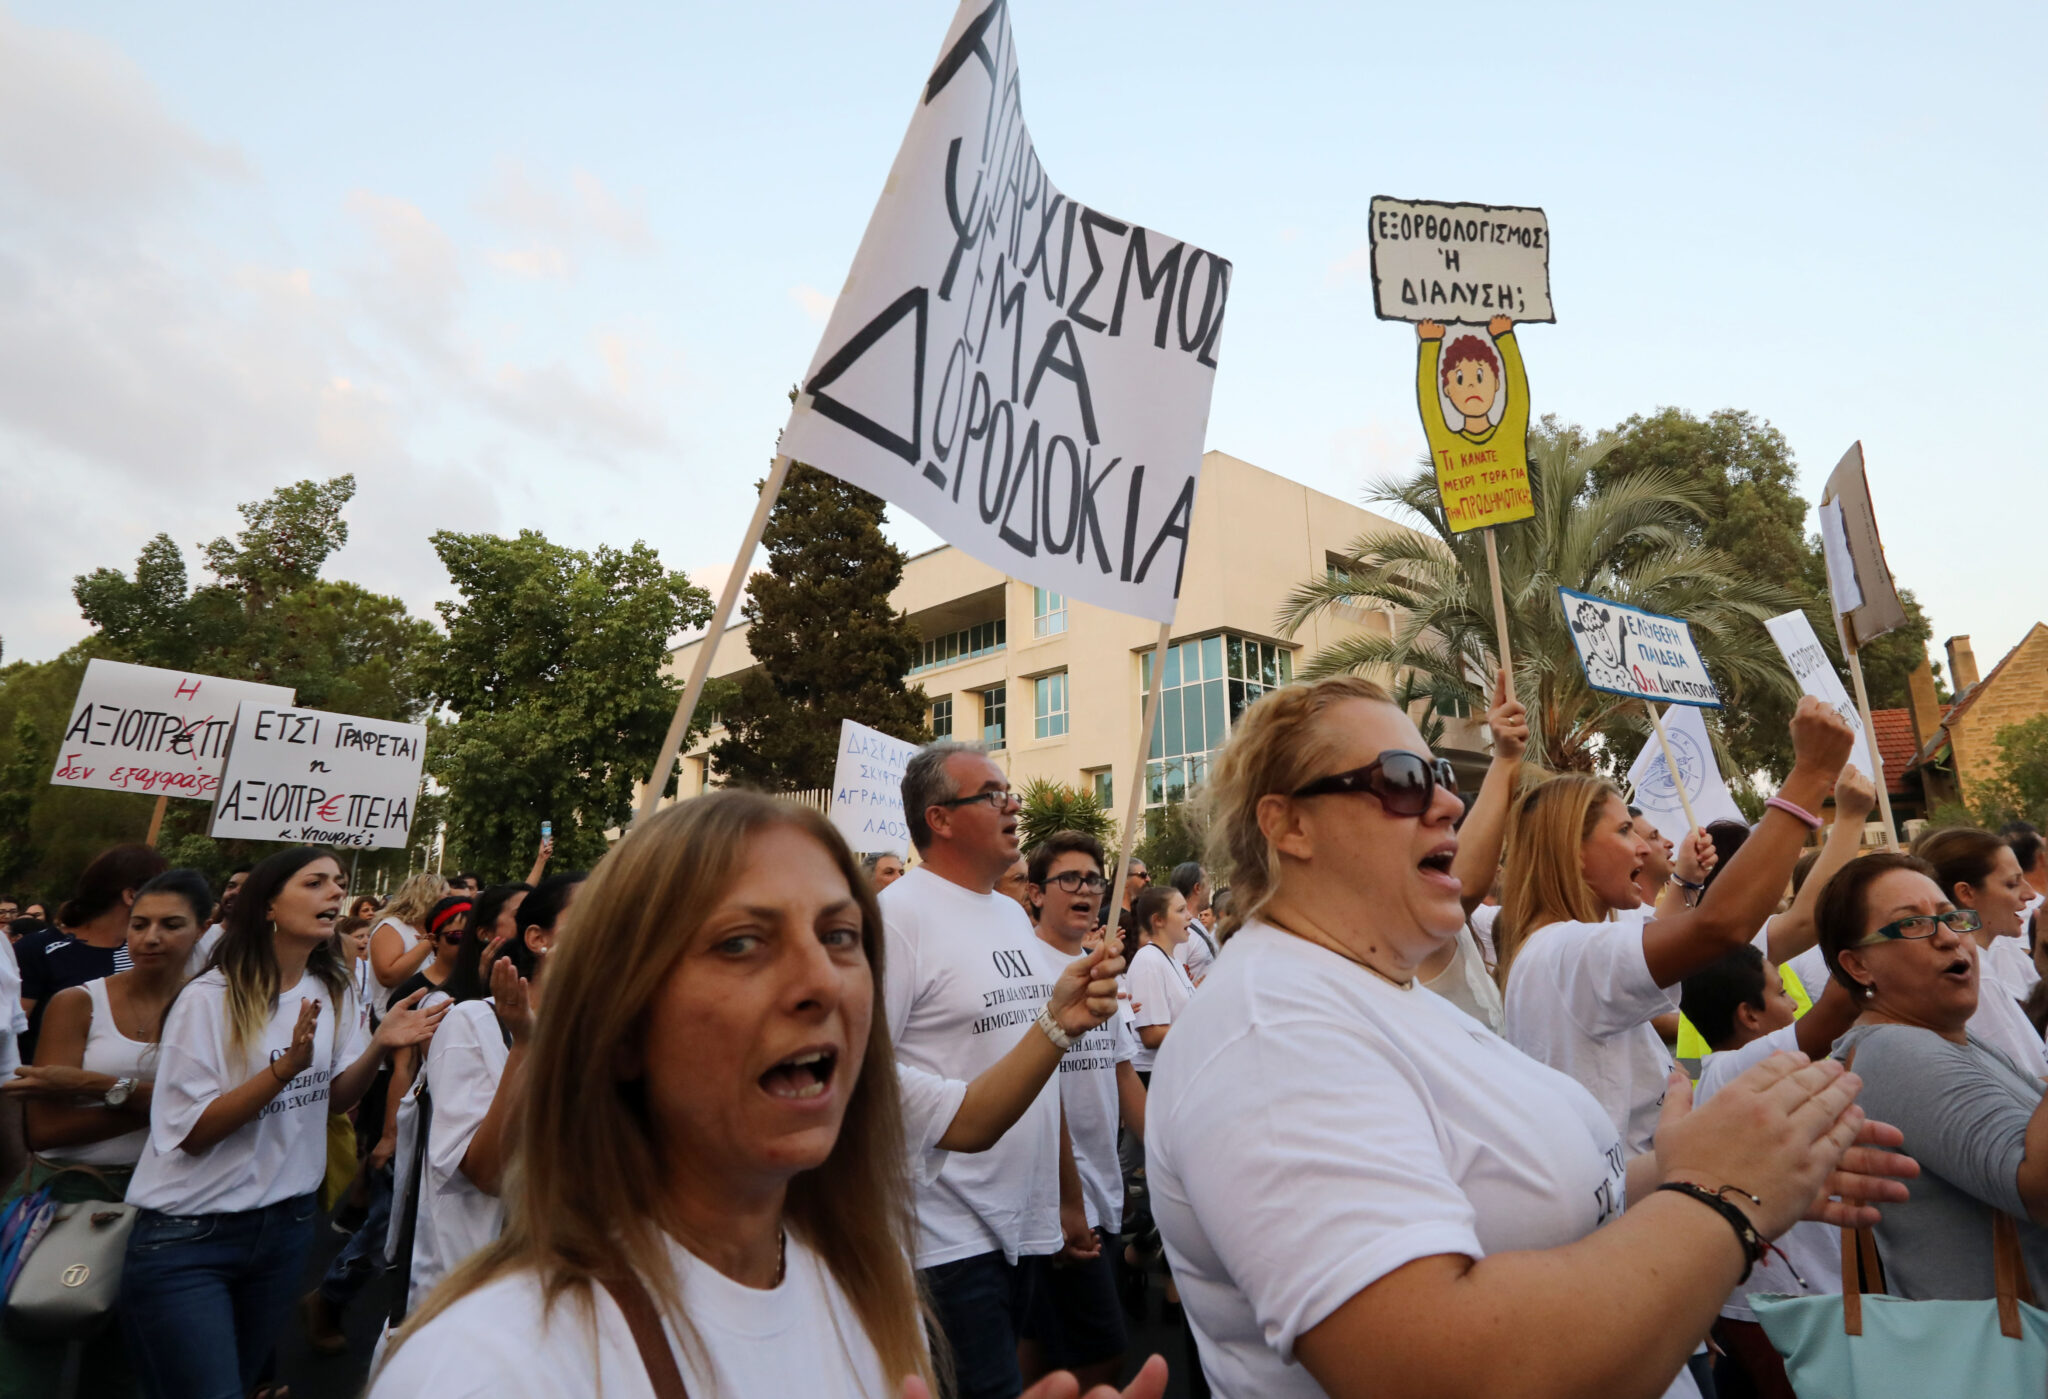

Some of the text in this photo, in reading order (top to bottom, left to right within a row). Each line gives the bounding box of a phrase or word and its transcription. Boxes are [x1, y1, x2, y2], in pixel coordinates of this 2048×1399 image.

[1378, 211, 1544, 249] ΕΞΟΡΘΟΛΟΓΙΣΜΟΣ
[1401, 277, 1526, 313] ΔΙΑΛΥΣΗ;
[1460, 449, 1498, 468] ΚΑΝΑΤΕ
[1443, 475, 1475, 493] ΜΕΧΡΙ
[1510, 467, 1526, 481] ΓΙΑ
[1626, 615, 1682, 647] ΕΛΕΥΘΕΡΗ
[1637, 643, 1690, 669] ΠΑΙΔΕΙΑ
[174, 678, 202, 701] Η
[254, 710, 419, 762] ΕΤΣΙ ΓΡΑΦΕΤΑΙ
[56, 754, 94, 780] δεν
[863, 818, 908, 841] ΛΑΟΣ
[992, 949, 1035, 979] ΟΧΙ
[983, 987, 1005, 1008] ΣΤΗ
[1040, 983, 1055, 999] ΤΟ
[972, 1008, 1028, 1035] ΔΗΜΟΣΙΟΥ
[1059, 1057, 1098, 1073] ΗΜΟΣΙΟ
